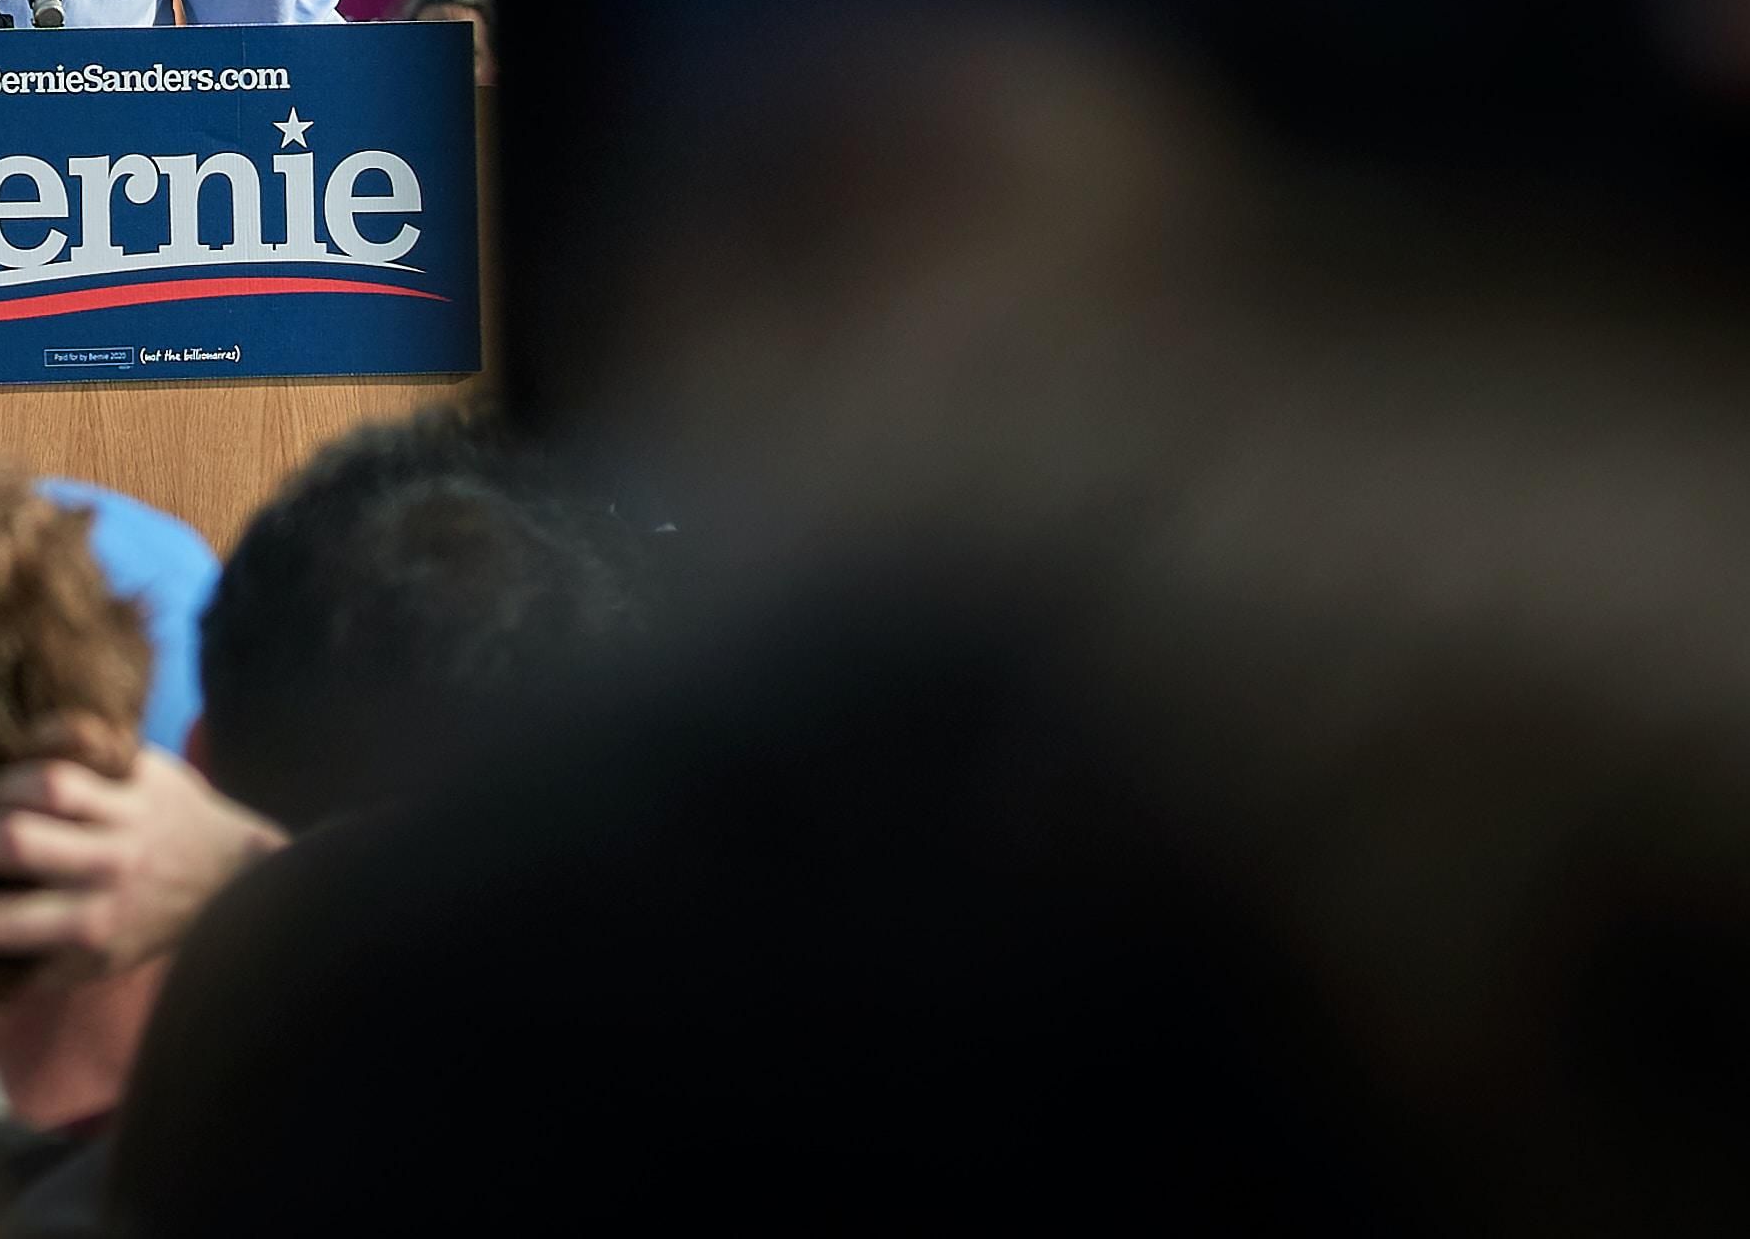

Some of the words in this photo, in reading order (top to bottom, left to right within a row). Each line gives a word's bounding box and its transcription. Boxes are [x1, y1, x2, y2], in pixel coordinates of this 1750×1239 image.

[54, 353, 68, 361] Paid
[69, 353, 78, 361] for
[79, 353, 88, 362] by
[89, 352, 109, 361] Bernie
[110, 352, 127, 360] 2020
[139, 347, 160, 364] (not
[164, 349, 181, 361] the
[183, 345, 241, 362] billionaires)
